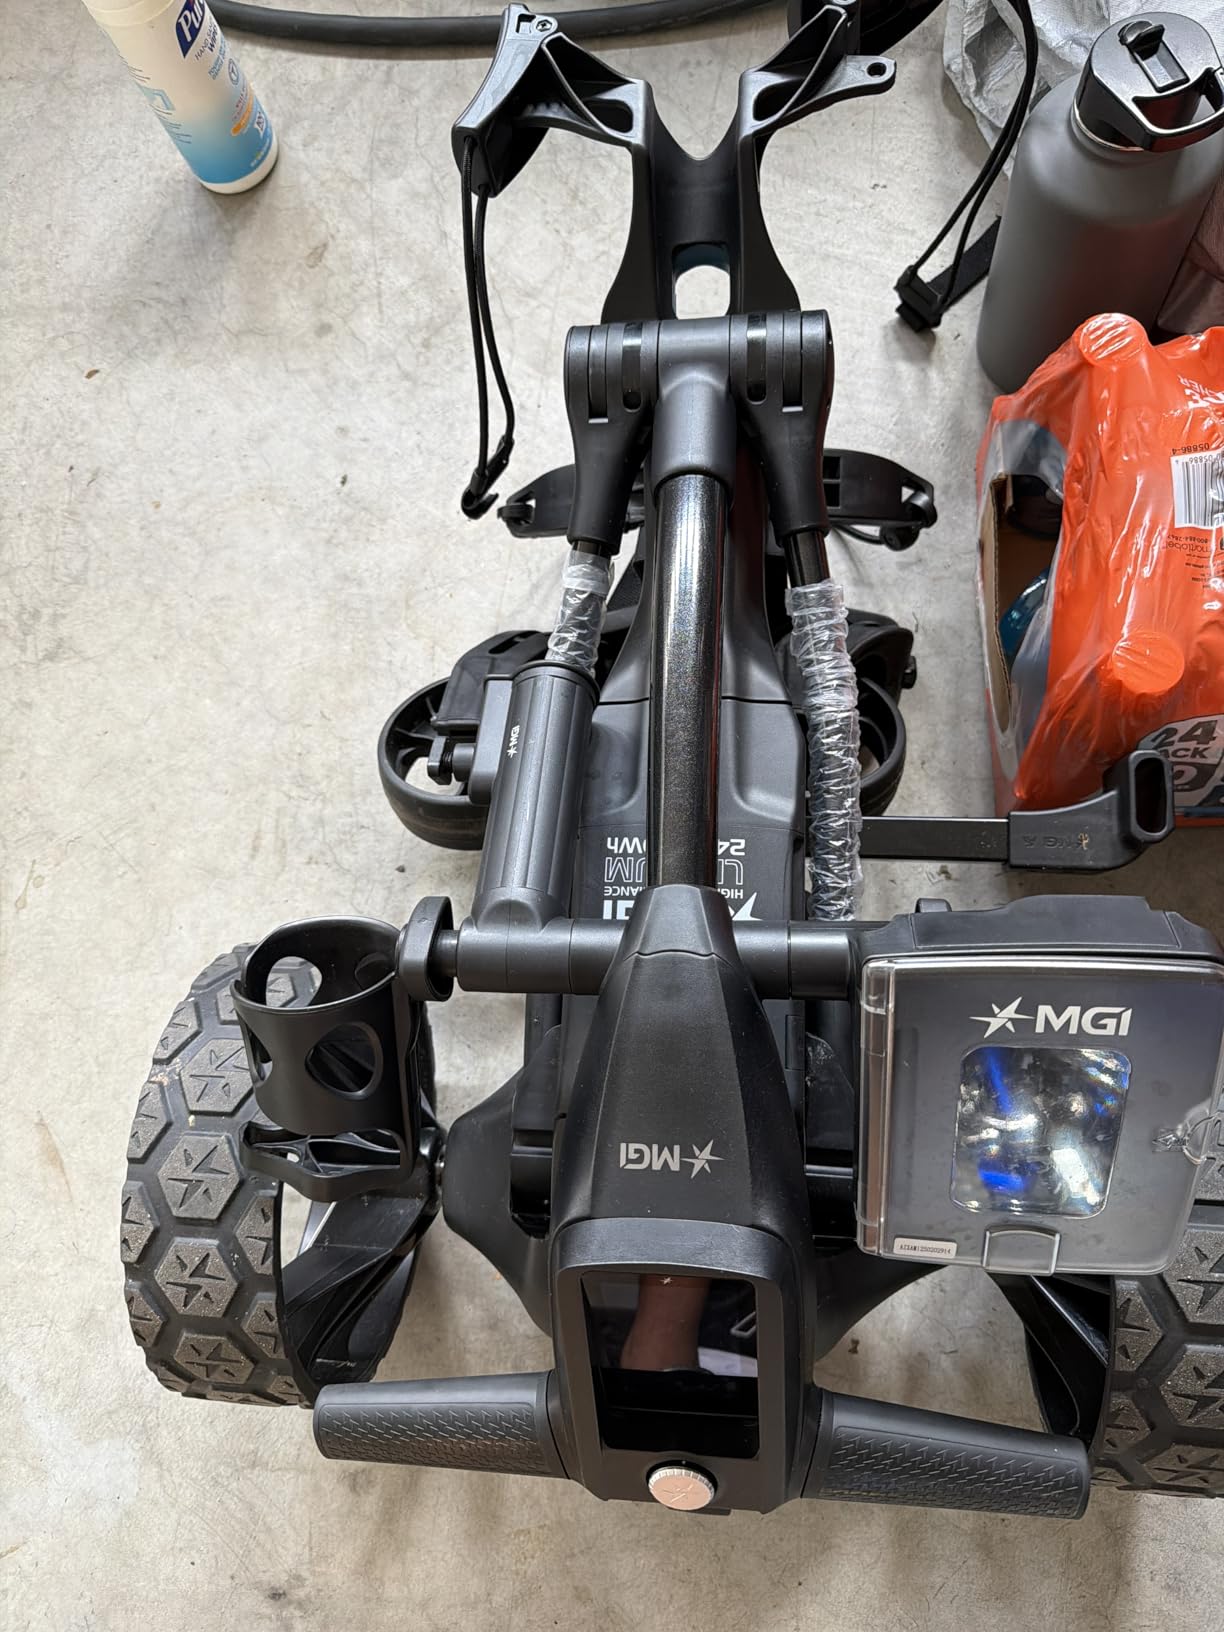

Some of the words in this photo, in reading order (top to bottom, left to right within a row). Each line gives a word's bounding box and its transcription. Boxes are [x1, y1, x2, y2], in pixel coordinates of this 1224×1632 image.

[508, 724, 521, 747] MGI
[1151, 719, 1218, 749] 24
[1160, 746, 1211, 759] ACK
[606, 836, 647, 854] Wh
[717, 888, 744, 900] HIG
[1035, 1005, 1133, 1036] MGI
[619, 1142, 680, 1172] MGI
